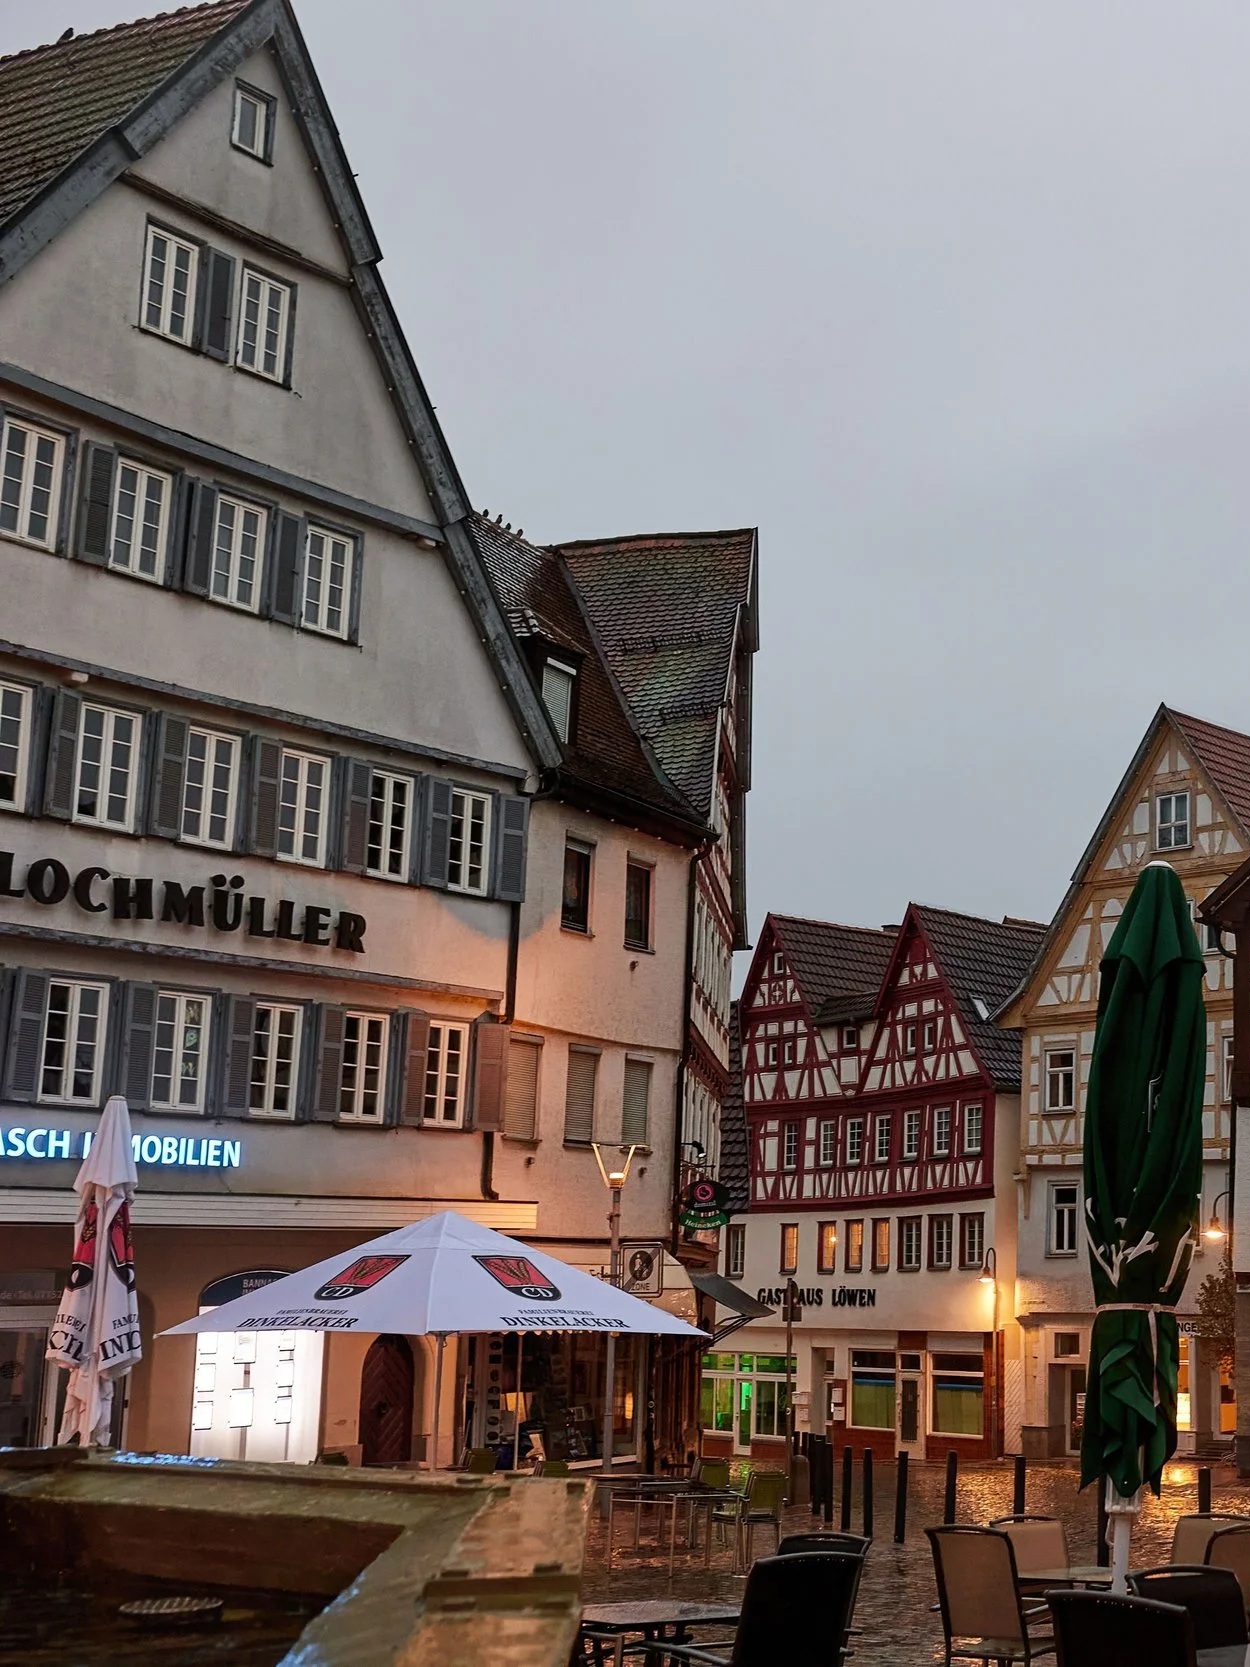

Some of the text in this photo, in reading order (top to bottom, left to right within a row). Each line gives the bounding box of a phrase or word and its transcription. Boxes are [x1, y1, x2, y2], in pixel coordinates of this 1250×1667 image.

[83, 1131, 241, 1168] IOBILIEN
[684, 1219, 721, 1228] Heineken
[321, 1287, 354, 1297] CD
[631, 1282, 651, 1291] ZONE
[521, 1287, 554, 1298] CD
[757, 1286, 876, 1307] GASTAUS LÖWEN
[236, 1316, 359, 1328] DINKELACKER
[500, 1316, 630, 1328] DINKELACKER
[1178, 1322, 1197, 1332] NGE
